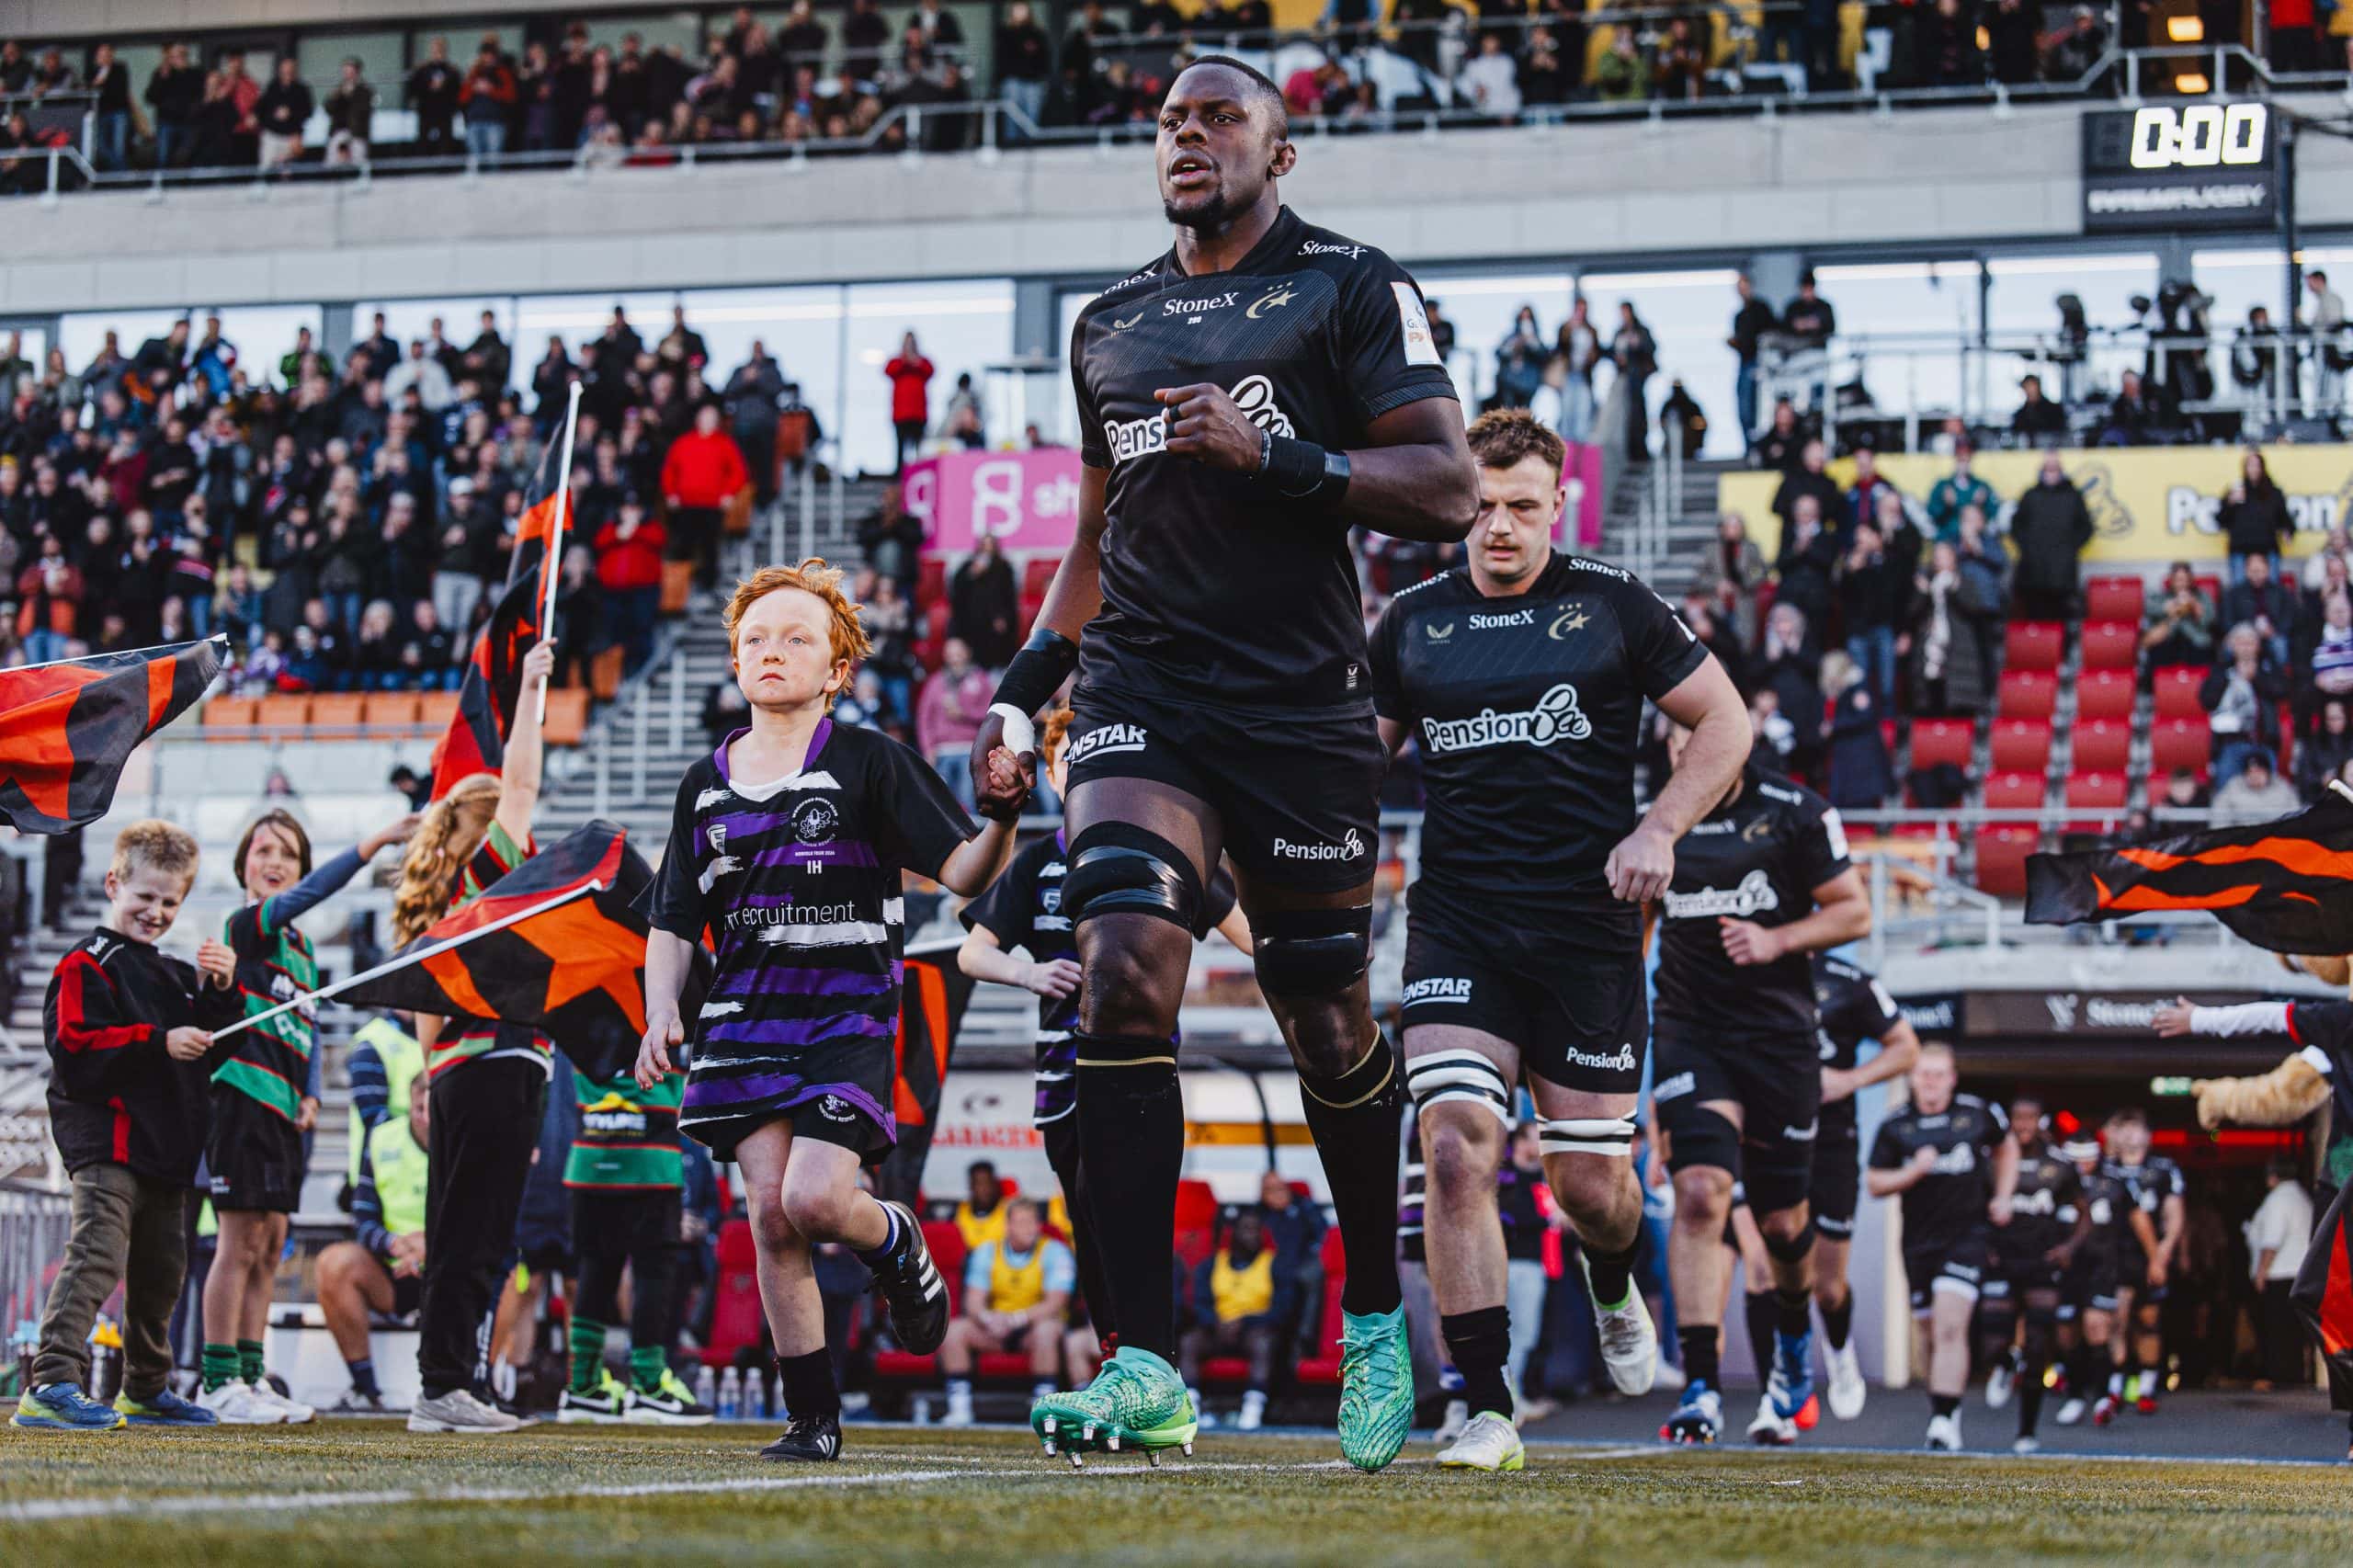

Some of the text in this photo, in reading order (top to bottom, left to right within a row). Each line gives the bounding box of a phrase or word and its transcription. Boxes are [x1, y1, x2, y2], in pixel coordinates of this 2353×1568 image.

[2131, 103, 2267, 168] 0:00
[1298, 240, 1368, 260] StoneX
[1104, 265, 1157, 295] oneX
[1163, 291, 1239, 316] StoneX
[1569, 558, 1632, 583] StoneX
[1469, 609, 1535, 631] StoneX
[1423, 684, 1591, 752] PensionBee
[1274, 828, 1365, 861] PensionBee
